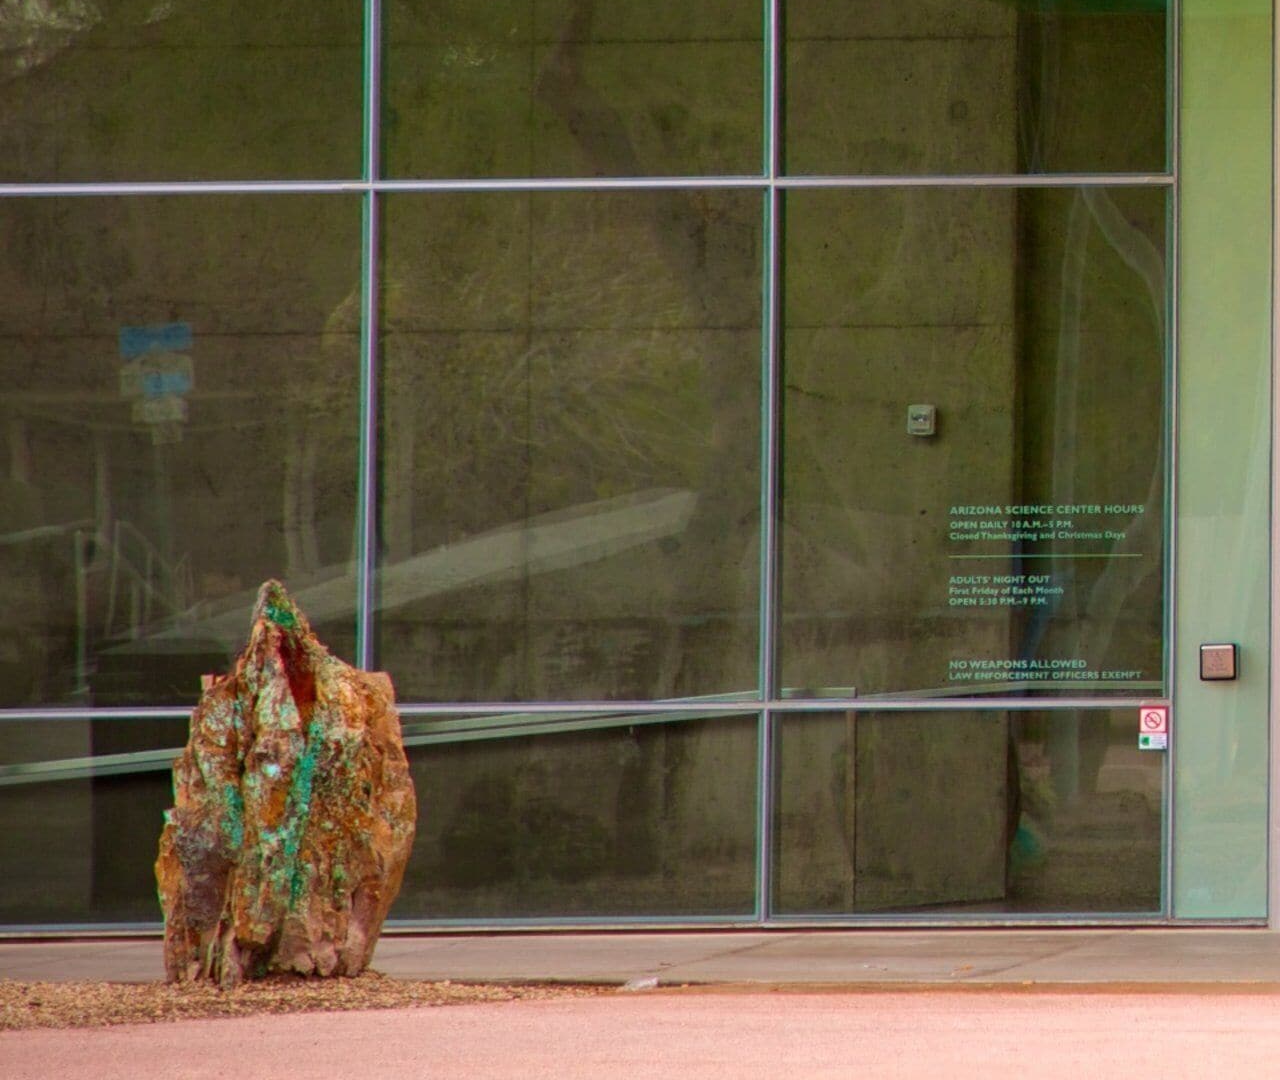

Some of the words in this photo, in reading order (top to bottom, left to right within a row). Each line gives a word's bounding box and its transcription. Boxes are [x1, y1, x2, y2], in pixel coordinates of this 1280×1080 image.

[950, 505, 1002, 515] ARIZONA
[1005, 505, 1053, 515] SCIENCE
[1056, 505, 1102, 514] CENTER
[1104, 504, 1145, 514] HOURS
[950, 521, 978, 529] OPEN
[980, 521, 1008, 529] DAILY
[950, 532, 980, 540] Closed
[981, 531, 1038, 542] Thanksgiving
[1039, 531, 1056, 540] and
[1057, 531, 1103, 539] Christmas
[1105, 531, 1126, 541] Days
[993, 575, 1026, 585] NIGHT
[1028, 575, 1051, 584] OUT
[949, 587, 970, 595] First
[972, 587, 999, 598] Friday
[1001, 587, 1011, 596] of
[1012, 586, 1034, 595] Each
[1035, 586, 1064, 595] Month
[949, 598, 976, 606] OPEN
[949, 660, 968, 670] NO
[970, 660, 1028, 670] WEAPONS
[1030, 659, 1087, 669] ALLOWED
[949, 672, 972, 681] LAW
[974, 671, 1049, 680] ENFORCEMENT
[1052, 671, 1100, 680] OFFICERS
[1102, 671, 1142, 679] EXEMPT
